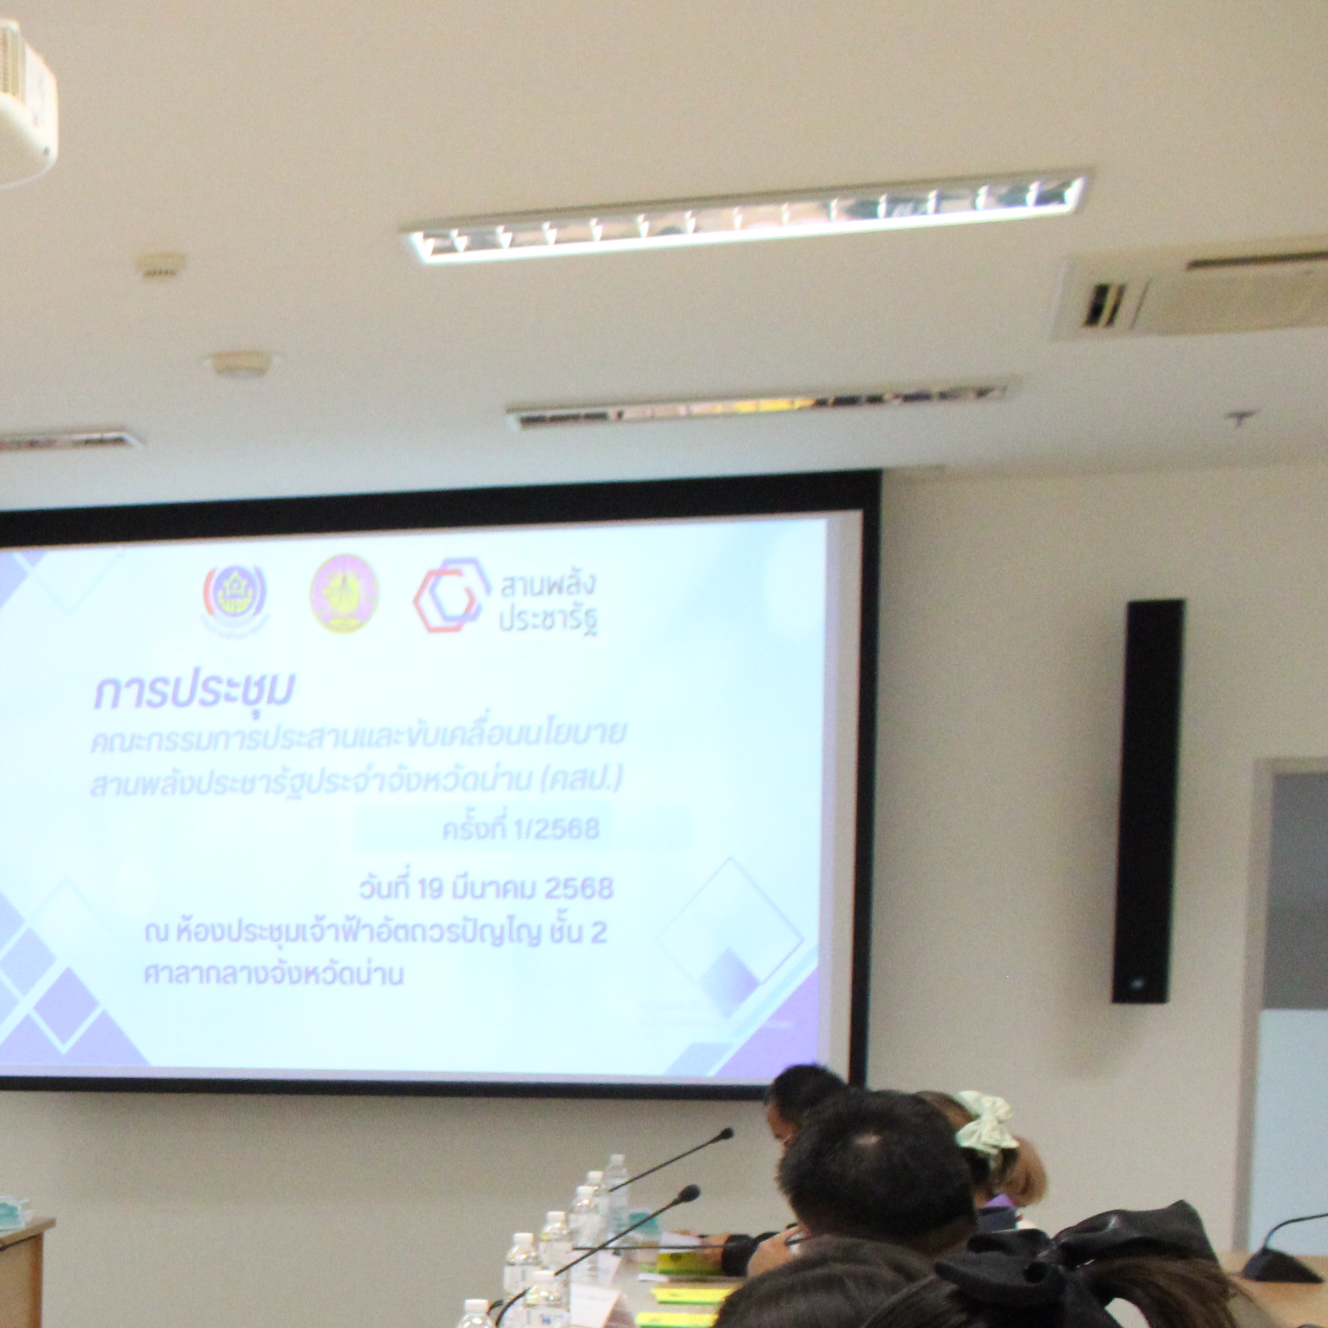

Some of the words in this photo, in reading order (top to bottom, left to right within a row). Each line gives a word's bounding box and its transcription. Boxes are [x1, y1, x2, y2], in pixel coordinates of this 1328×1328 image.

[500, 566, 596, 598] สานพลัง
[499, 602, 598, 638] ประชารัฐ
[93, 666, 296, 721] การประชุม
[91, 707, 629, 753] คณะกรรมการประสานและขับเคลื่อนนโยบาย
[90, 762, 533, 800] สานพลังประชารัฐประจำจังหวัดน่าน
[540, 762, 624, 794] (คสป.)
[443, 805, 508, 841] ครั้งที่
[514, 816, 601, 840] 1/2568
[359, 863, 411, 900] วันที่
[418, 876, 444, 900] 19
[452, 870, 537, 900] มีนาคม
[544, 876, 615, 900] 2568
[144, 922, 170, 942] ณ
[549, 907, 584, 944] ชั้น
[590, 920, 609, 944] 2
[144, 957, 405, 986] ศาลากลางจังหวัดน่าน
